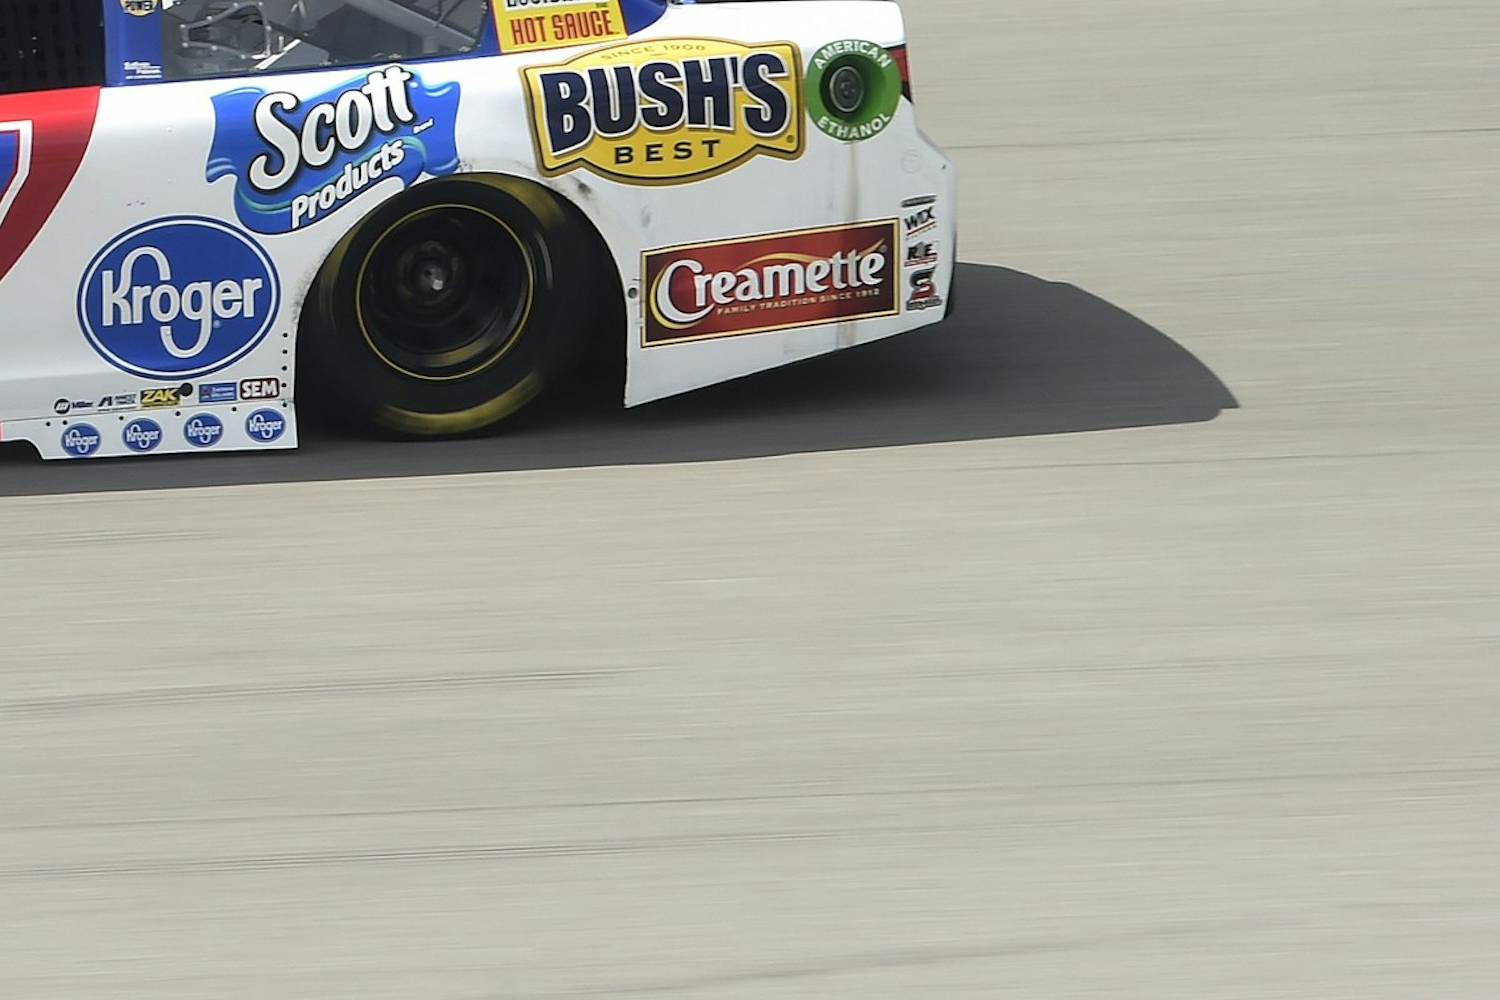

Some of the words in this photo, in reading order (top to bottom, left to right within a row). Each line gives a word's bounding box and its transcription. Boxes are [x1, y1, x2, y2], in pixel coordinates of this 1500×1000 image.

[510, 16, 547, 45] HOT
[551, 10, 614, 41] SAUCE
[601, 45, 656, 60] SINCE
[814, 41, 892, 69] AMERICAN
[539, 52, 789, 156] BUSH'S
[249, 65, 416, 192] Scott
[817, 113, 891, 139] ETHANOL
[614, 139, 721, 164] BEST
[291, 138, 406, 229] Products
[656, 249, 886, 323] Creamette
[101, 246, 264, 358] Kroger
[717, 304, 756, 315] FAMILY
[760, 298, 816, 309] TRADITION
[819, 292, 852, 303] SINCE
[856, 289, 880, 298] 1912
[142, 388, 177, 403] ZAK
[242, 381, 279, 398] SEM
[126, 424, 160, 448] Kroger
[188, 419, 221, 444] Kroger
[249, 414, 283, 438] Kroger
[65, 429, 99, 453] Kroger
